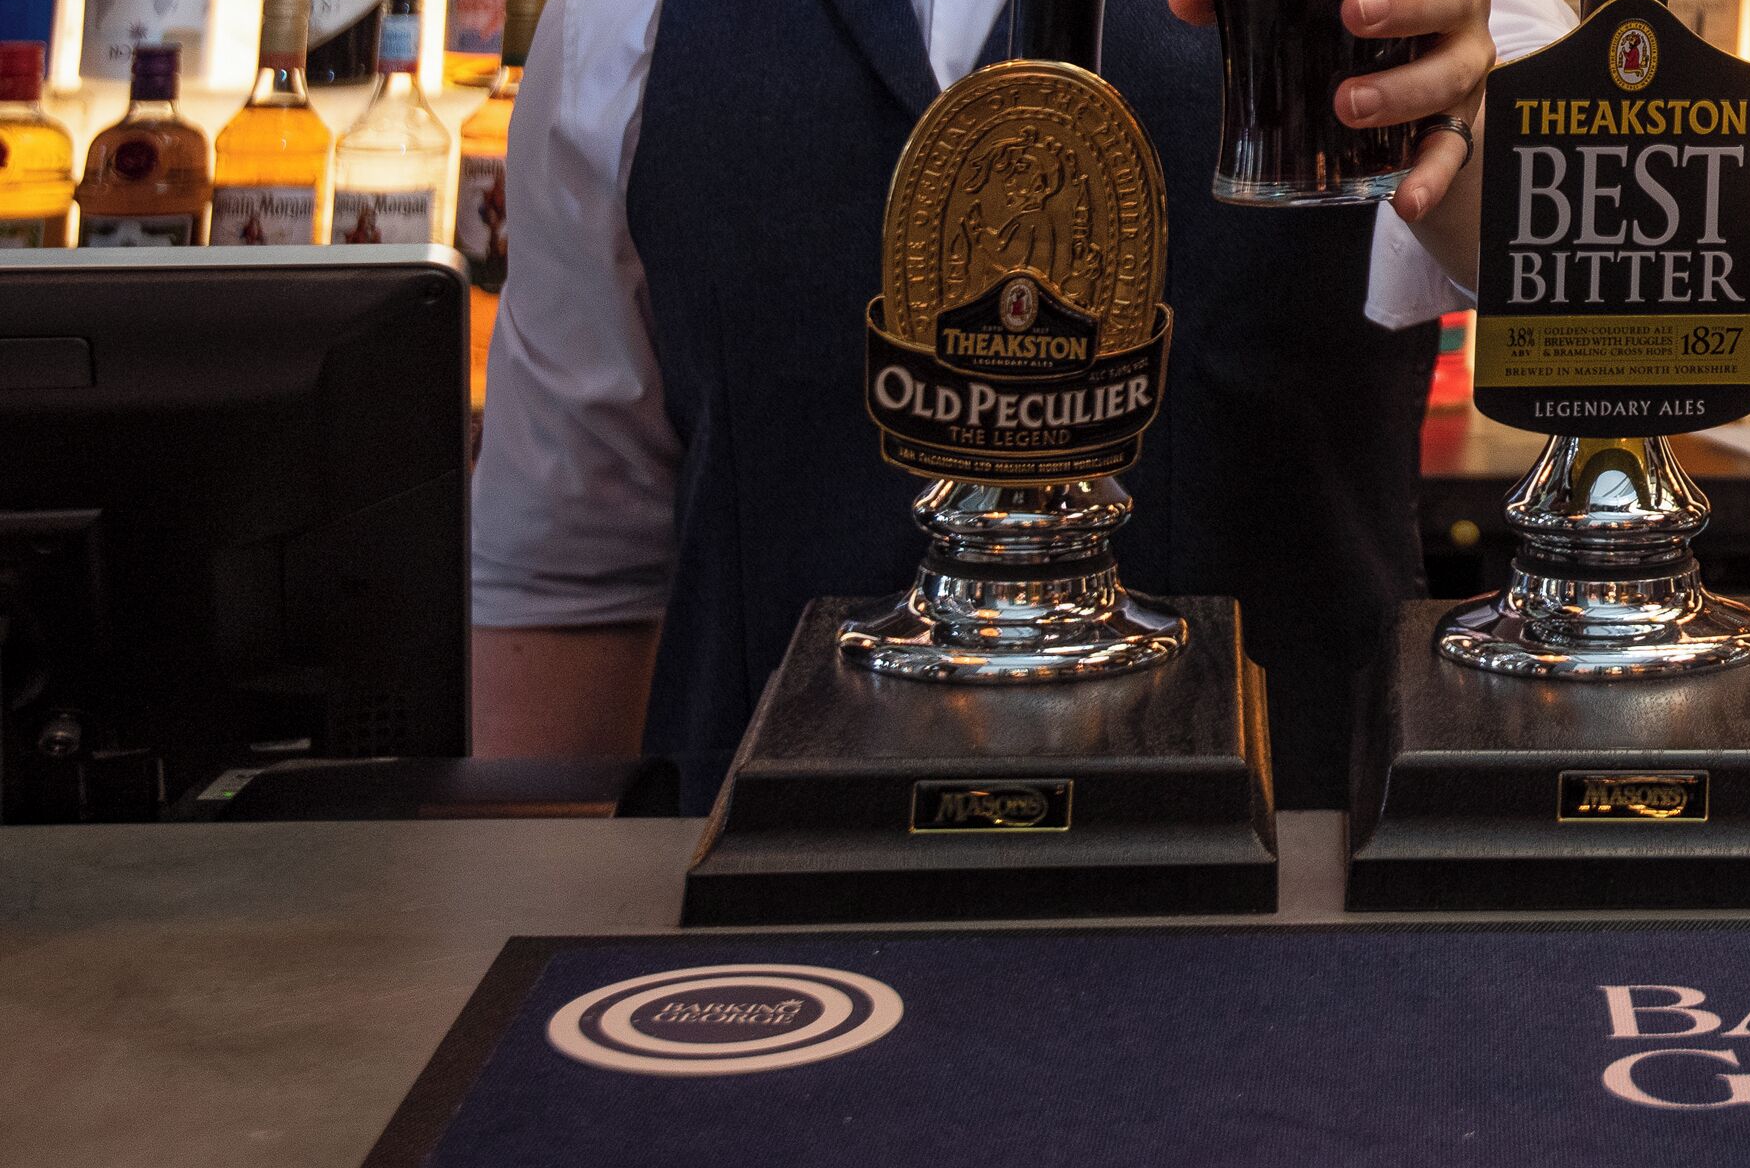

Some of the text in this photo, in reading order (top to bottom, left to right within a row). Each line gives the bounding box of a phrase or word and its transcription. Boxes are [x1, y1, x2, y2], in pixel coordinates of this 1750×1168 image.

[1515, 100, 1749, 135] THEAKSTON
[1510, 143, 1746, 247] BEST
[1506, 251, 1747, 304] BITTER
[942, 327, 1088, 361] THEAKSTON
[1544, 336, 1673, 347] BREWED WITH FUGGLES
[1681, 325, 1745, 356] 1827
[1511, 349, 1531, 357] ABV
[1553, 346, 1608, 357] BRAMLING
[1609, 347, 1644, 357] CROSS
[1645, 346, 1674, 357] HOPS
[1504, 364, 1738, 377] BREWED IN MASHAM NORTH YORKSHIRE
[875, 364, 1154, 430] OLD PECULIER
[1534, 399, 1706, 418] LEGENDARY ALES
[949, 425, 1073, 447] THE LEGEND
[662, 1001, 803, 1015] BARKING
[653, 1012, 796, 1025] GEORGE
